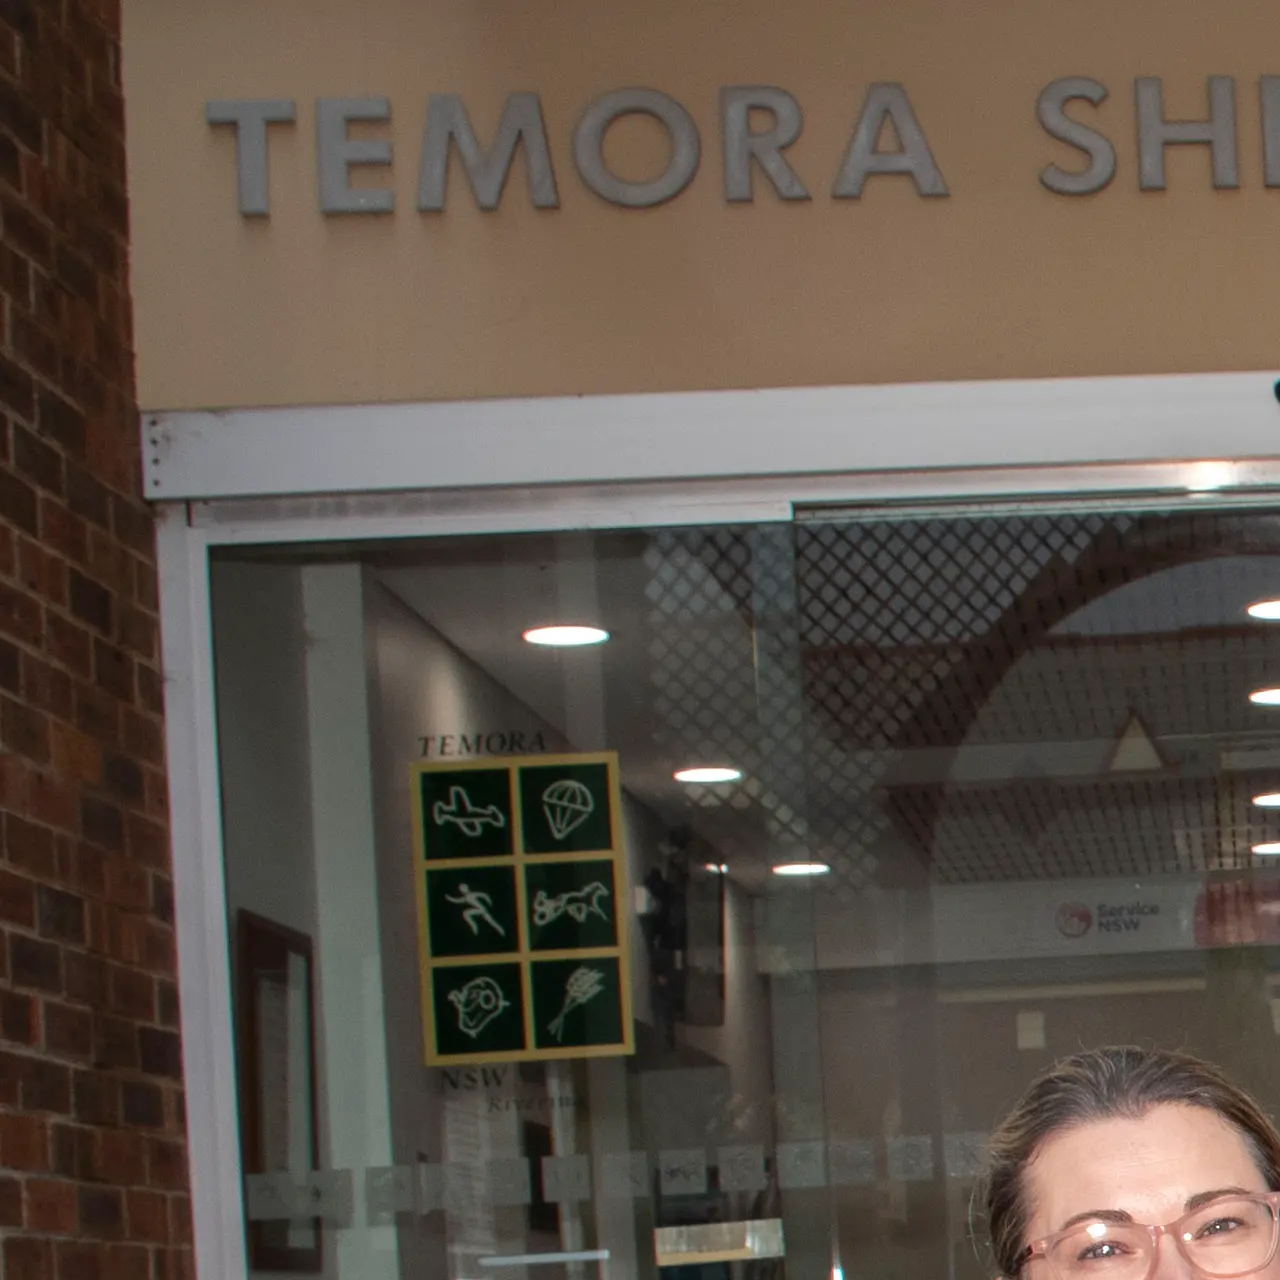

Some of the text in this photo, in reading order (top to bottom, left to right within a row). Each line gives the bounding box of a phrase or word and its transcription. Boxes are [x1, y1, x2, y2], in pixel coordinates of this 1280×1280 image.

[206, 81, 950, 217] TEMORA
[417, 730, 546, 757] TEMORA
[1097, 902, 1160, 917] Service
[1097, 918, 1140, 933] NSW
[440, 1065, 507, 1092] NSW
